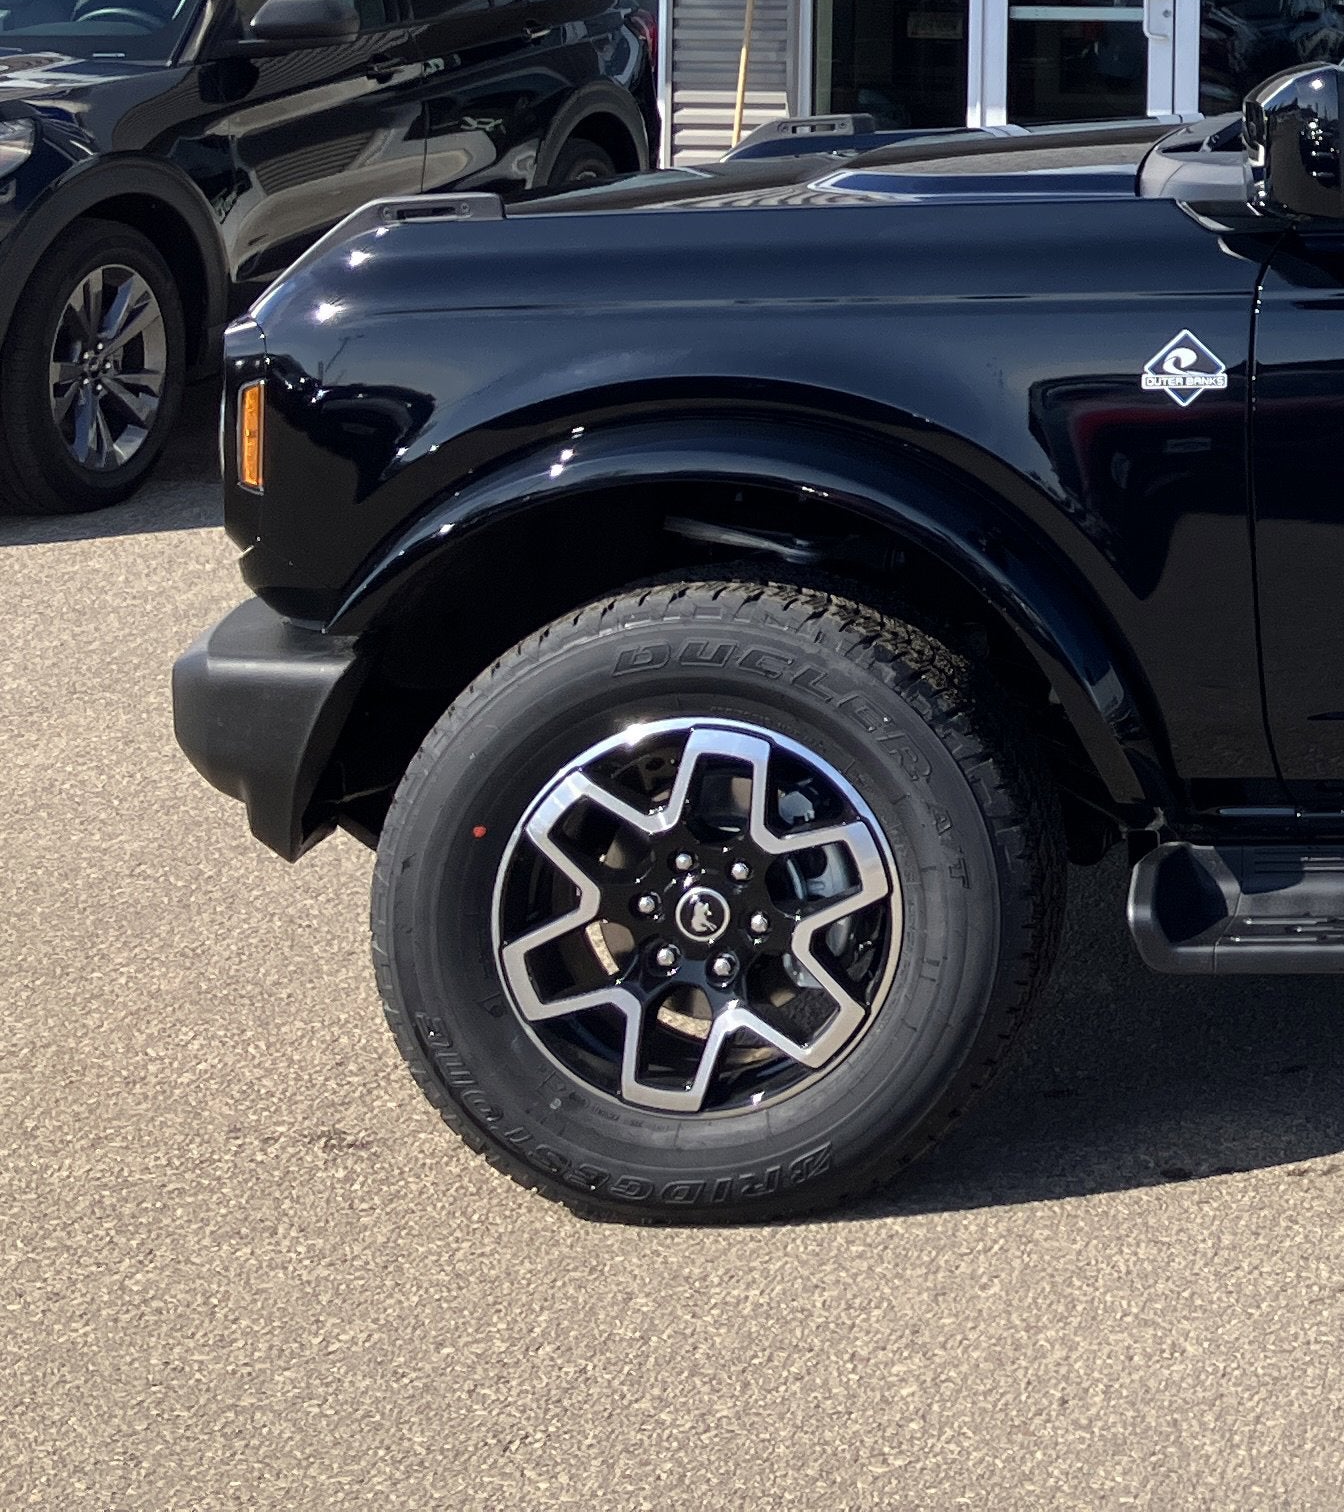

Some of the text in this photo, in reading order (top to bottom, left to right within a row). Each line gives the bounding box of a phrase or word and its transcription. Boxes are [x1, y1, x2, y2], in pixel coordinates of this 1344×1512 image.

[1146, 376, 1225, 386] OUTER BANKS
[611, 639, 934, 782] DUELER
[413, 1011, 833, 1204] BRIDGESTONE
